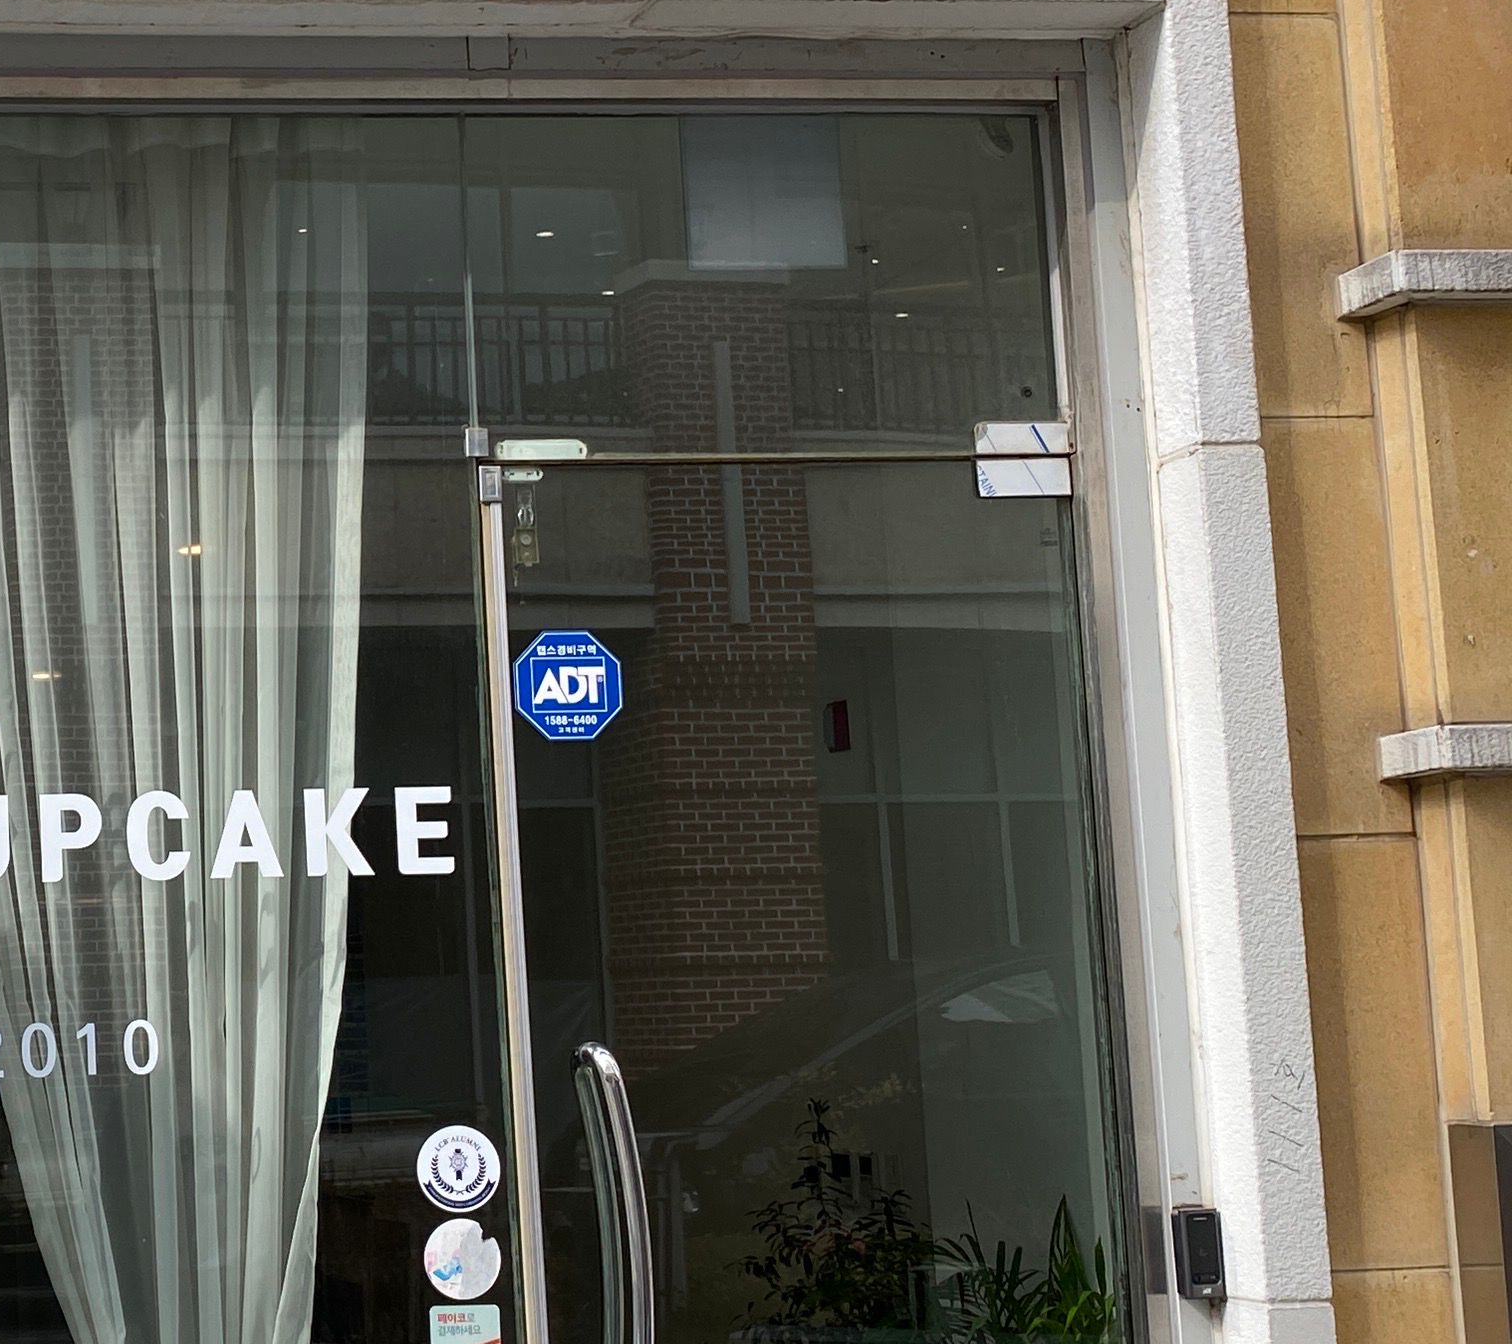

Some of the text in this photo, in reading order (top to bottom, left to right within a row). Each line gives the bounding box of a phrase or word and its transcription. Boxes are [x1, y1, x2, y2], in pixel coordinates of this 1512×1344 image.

[533, 665, 605, 705] ADT
[544, 714, 598, 726] 1588-6400
[451, 1135, 482, 1152] ALUMNI
